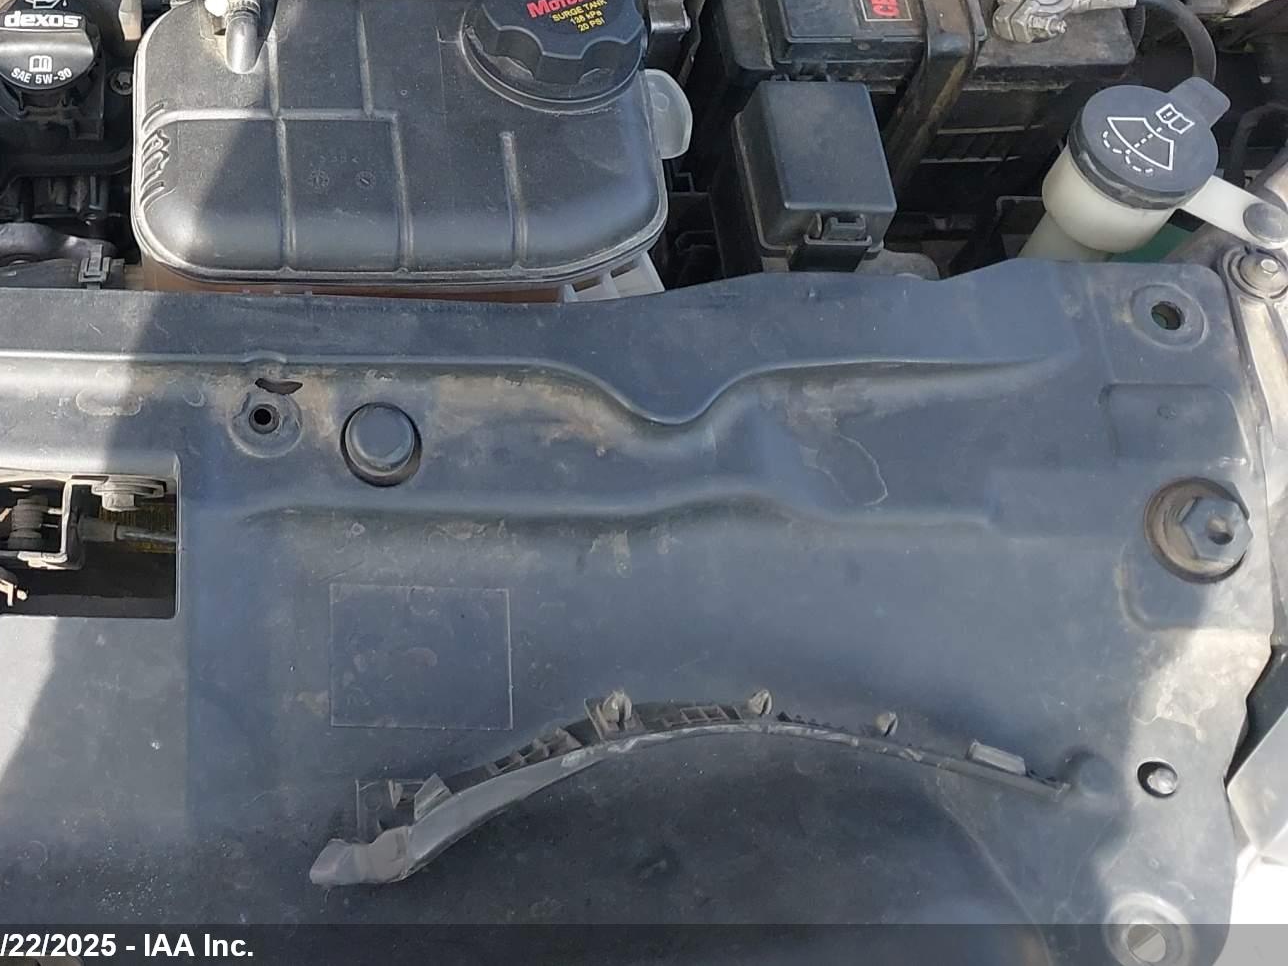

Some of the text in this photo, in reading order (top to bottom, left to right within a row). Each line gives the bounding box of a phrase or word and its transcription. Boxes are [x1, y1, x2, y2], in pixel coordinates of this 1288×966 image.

[4, 10, 81, 28] dexos
[551, 6, 583, 22] SURGE
[578, 18, 605, 32] 20 PSI
[11, 67, 72, 84] SAE 5W-30
